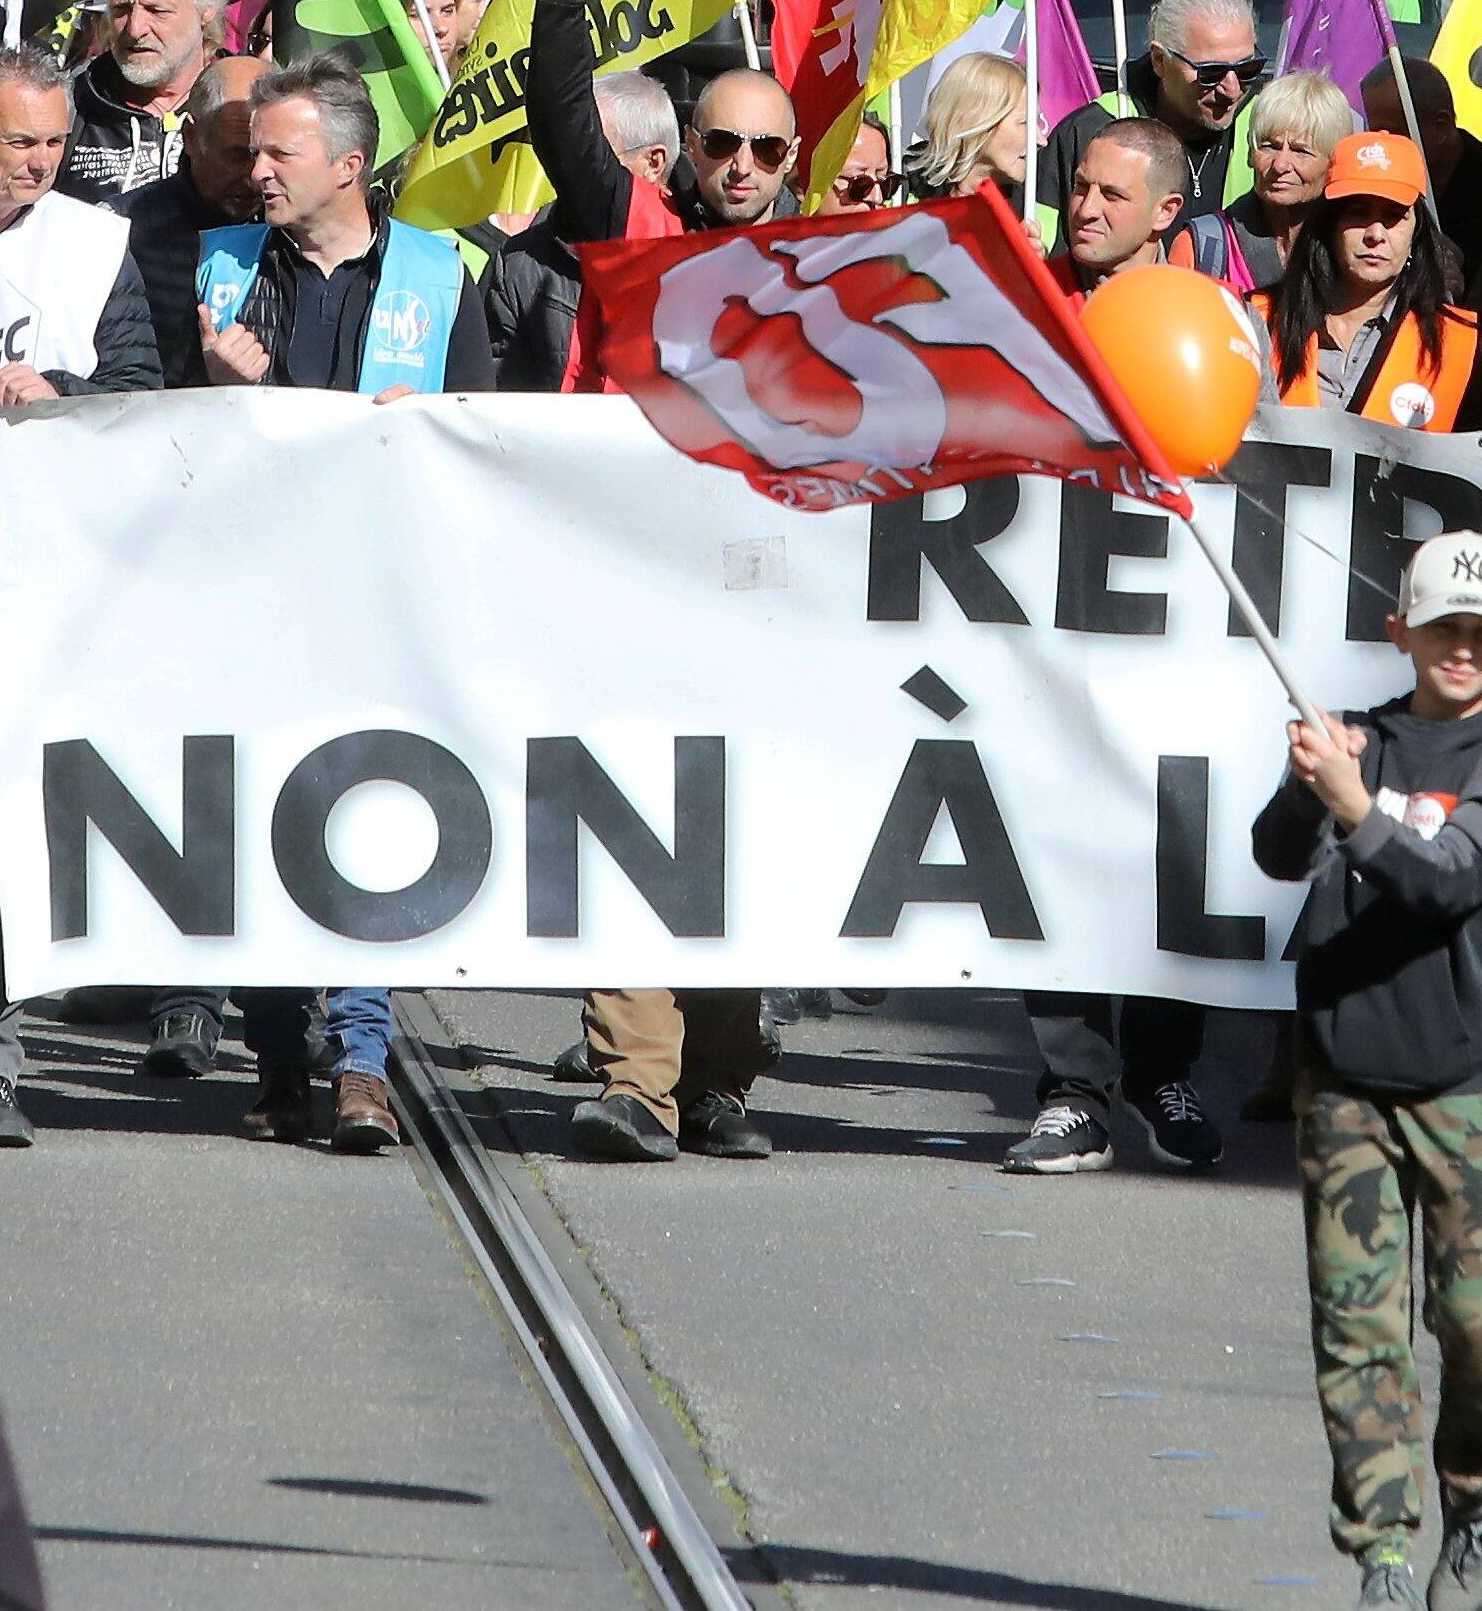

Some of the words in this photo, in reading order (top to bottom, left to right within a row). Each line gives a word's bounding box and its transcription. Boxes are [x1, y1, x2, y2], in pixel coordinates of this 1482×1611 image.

[42, 728, 726, 944] NON
[837, 664, 1043, 939] À
[1156, 755, 1309, 962] L
